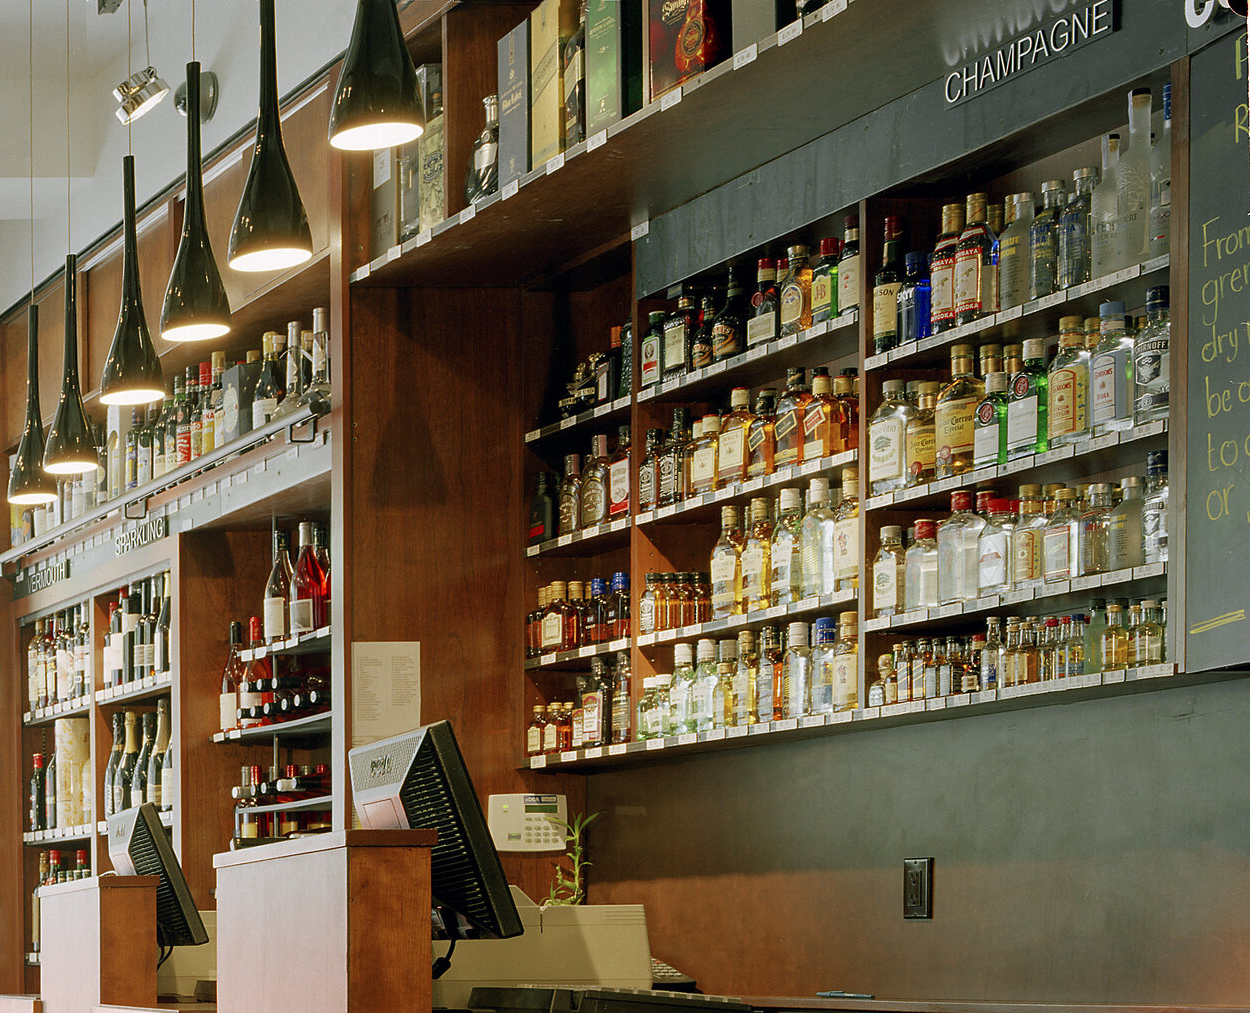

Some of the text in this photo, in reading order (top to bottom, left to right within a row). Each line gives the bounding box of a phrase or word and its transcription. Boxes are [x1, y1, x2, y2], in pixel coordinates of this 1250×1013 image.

[945, 0, 1109, 103] CHAMPAGNE
[1202, 325, 1238, 363] dry
[1205, 376, 1232, 418] be
[1207, 433, 1238, 471] to
[1206, 484, 1235, 520] or
[114, 517, 163, 556] SPARKLING
[28, 560, 66, 594] VERMOUTH
